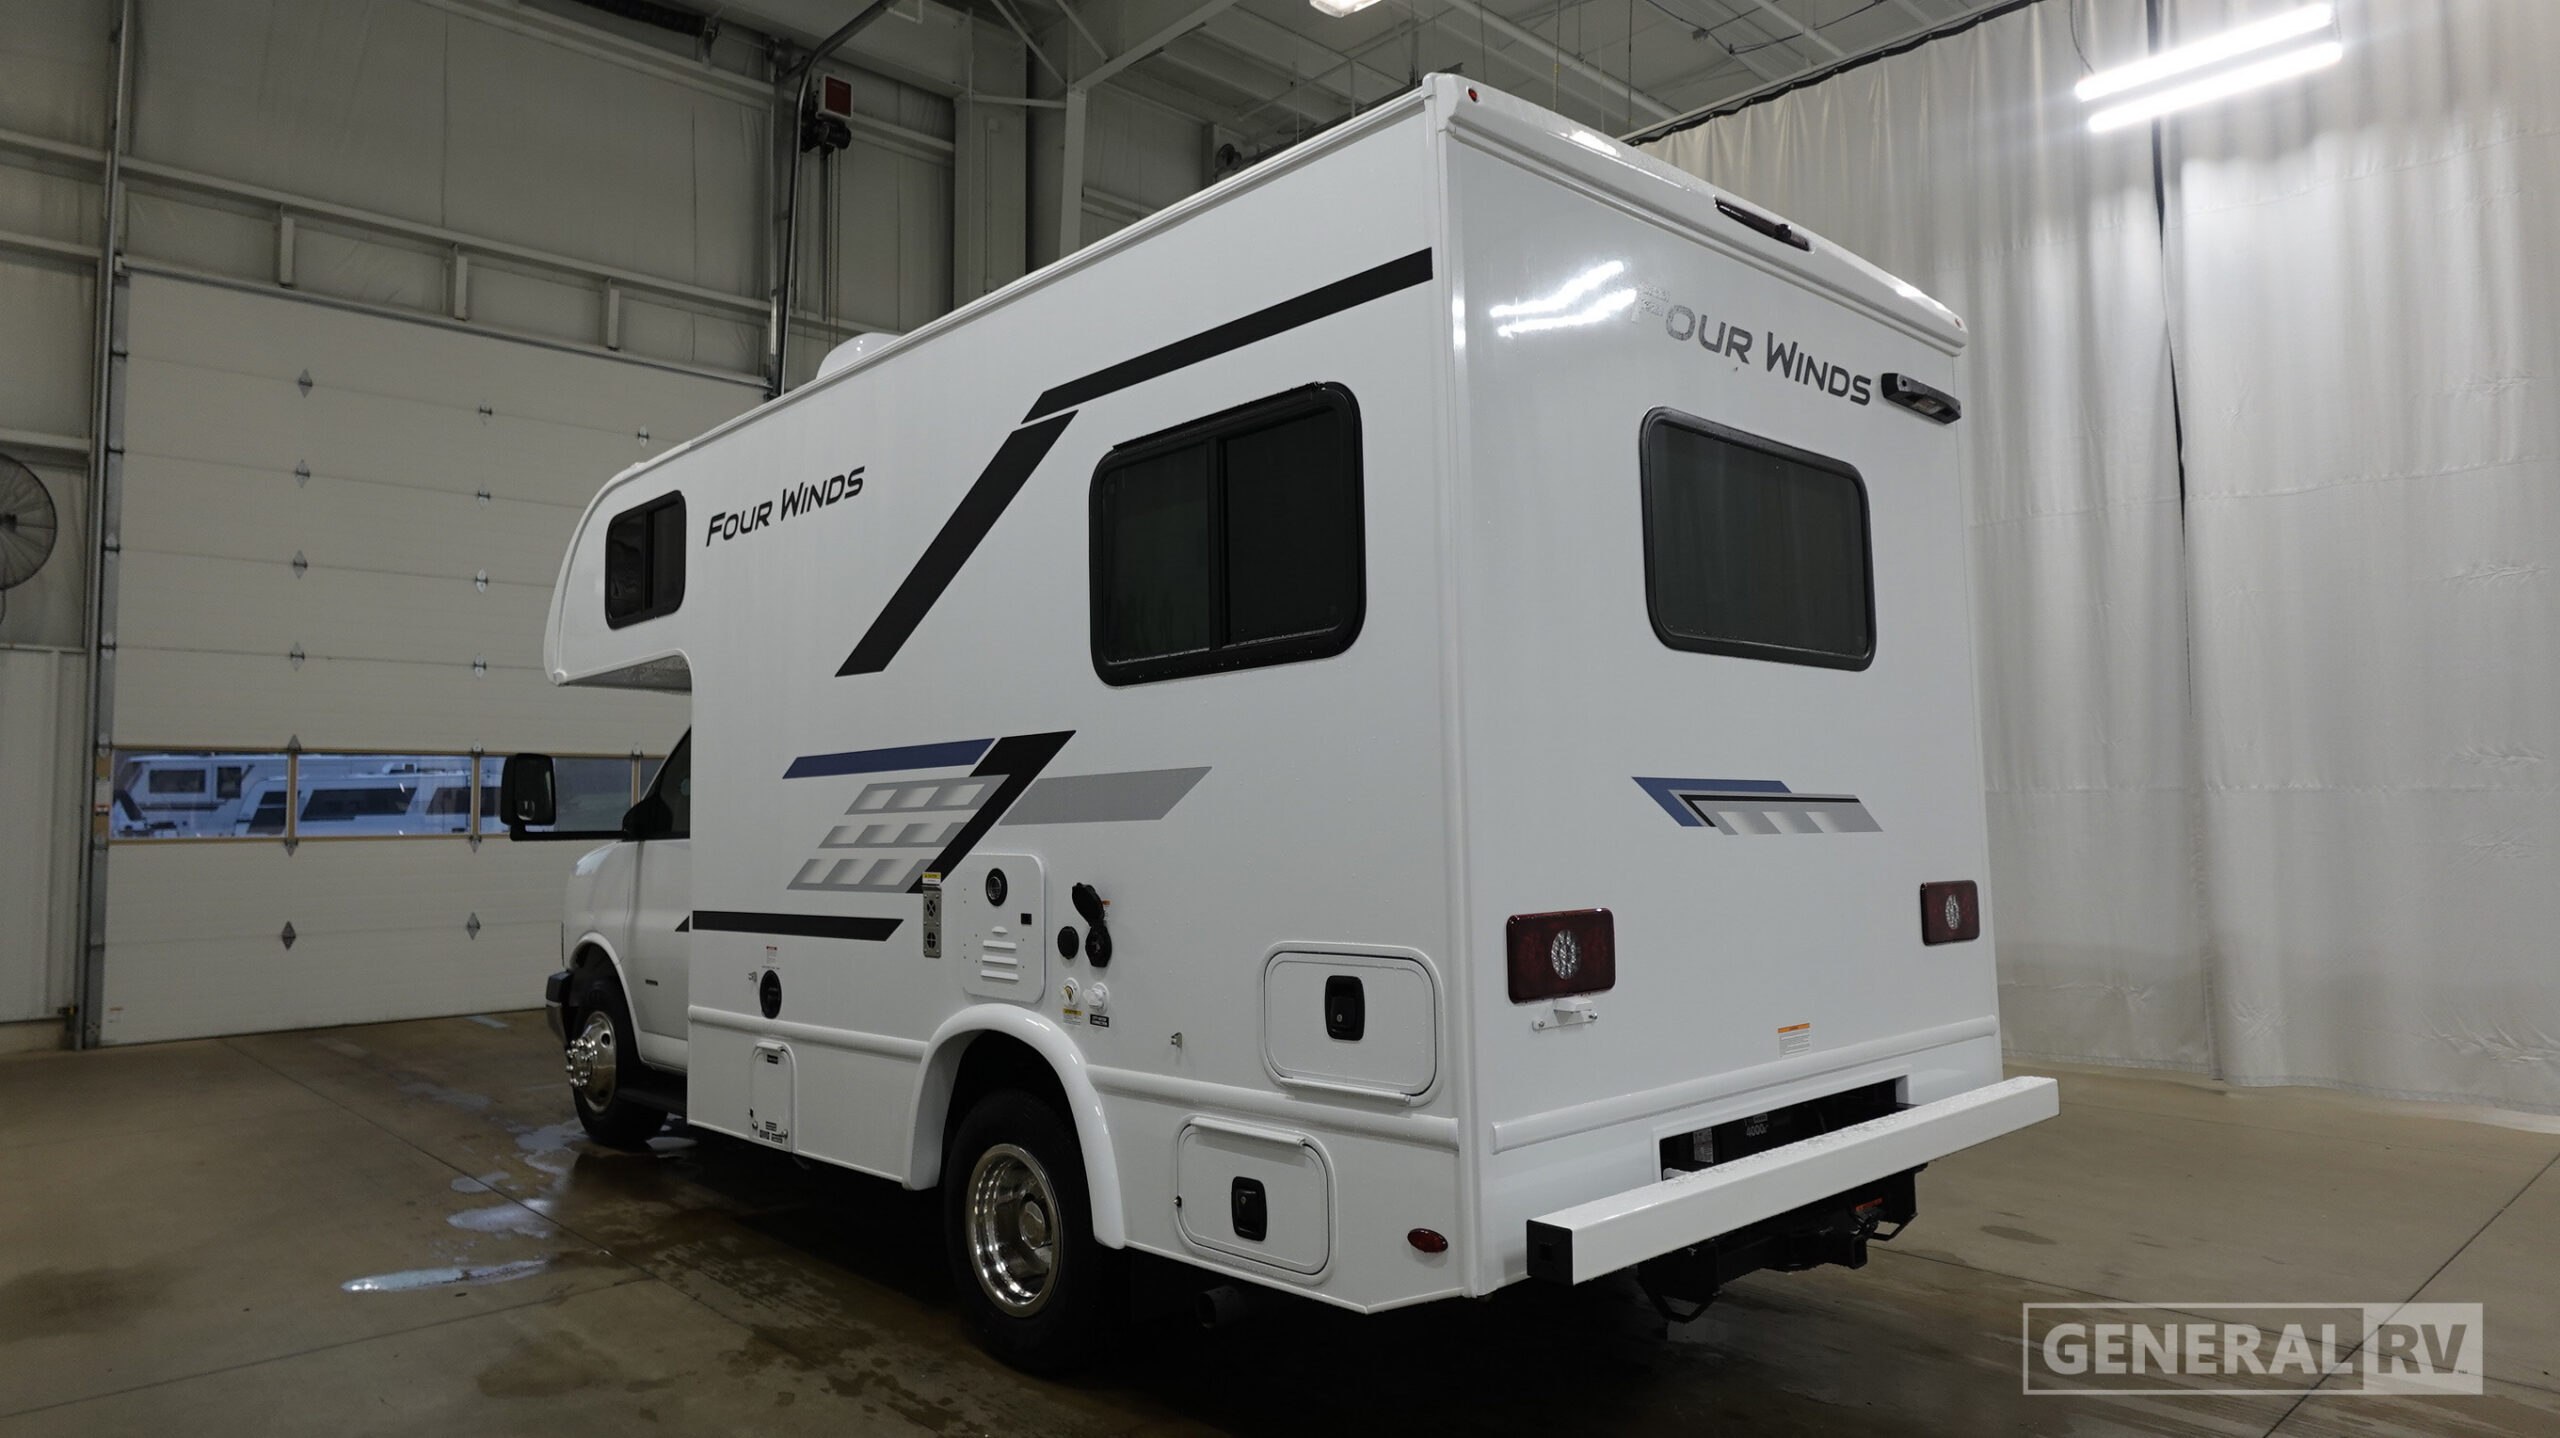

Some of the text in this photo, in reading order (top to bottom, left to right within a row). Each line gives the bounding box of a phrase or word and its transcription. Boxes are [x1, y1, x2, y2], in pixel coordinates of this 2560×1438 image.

[1631, 284, 1871, 406] FOUR WINDS
[706, 465, 865, 548] FOUR WINDS
